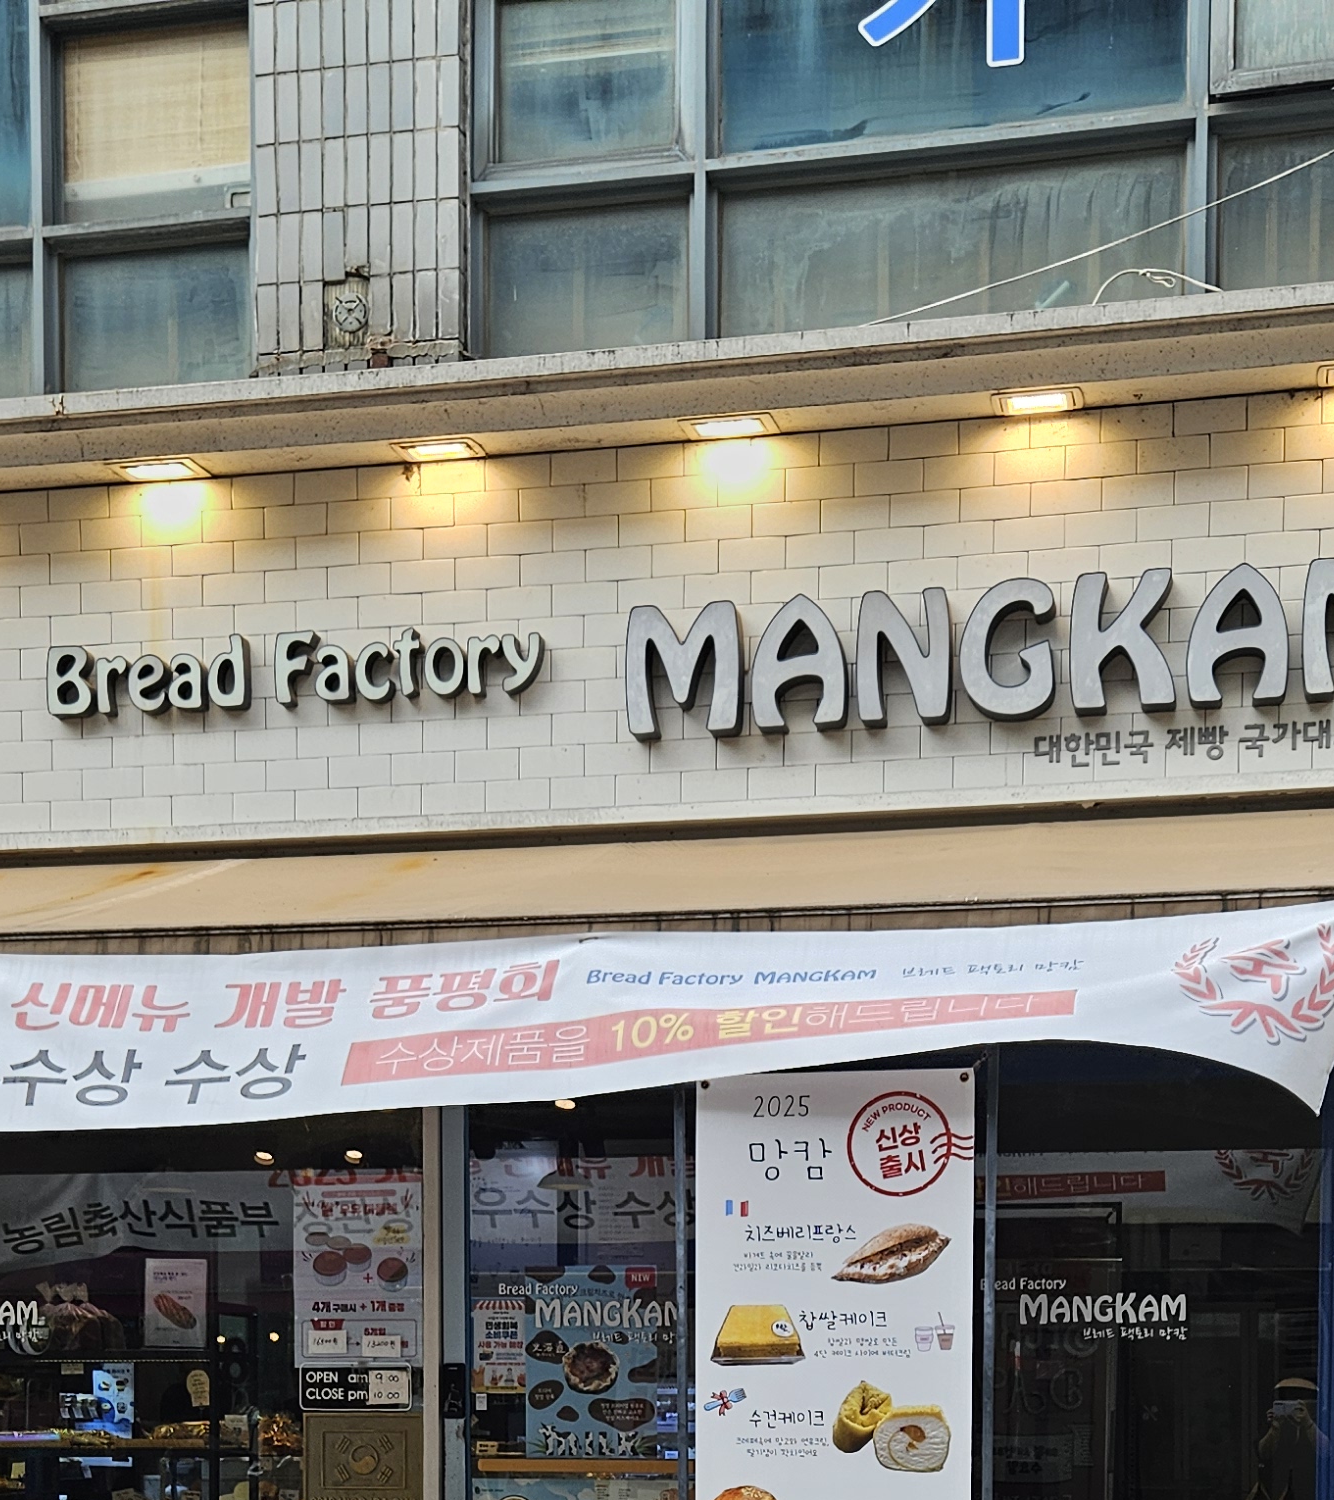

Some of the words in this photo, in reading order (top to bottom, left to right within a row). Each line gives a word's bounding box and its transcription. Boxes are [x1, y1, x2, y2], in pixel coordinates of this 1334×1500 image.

[46, 635, 250, 719] Bread
[274, 625, 547, 709] Factory
[1034, 726, 1152, 768] 대한민국
[1165, 722, 1230, 761] 제빵
[587, 968, 652, 986] Bread
[658, 970, 744, 989] Factory
[753, 966, 878, 985] MANGKAM
[11, 981, 192, 1032] 신메뉴
[214, 977, 347, 1031] 개발
[369, 959, 561, 1020] 품평회
[374, 1025, 591, 1075] 수상제품을
[611, 1013, 695, 1052] 10%
[164, 1044, 308, 1106] 수상
[753, 1095, 811, 1118] 2025
[862, 1111, 881, 1132] NEW
[882, 1102, 932, 1121] PRODUCT
[875, 1122, 921, 1152] 신상
[749, 1138, 833, 1181] 망캄
[879, 1150, 927, 1180] 출시
[2, 1197, 280, 1256] 농림축산식품부
[745, 1225, 857, 1244] 치즈베리프랑스
[499, 1284, 531, 1297] Bread
[535, 1283, 579, 1297] Factory
[980, 1278, 1016, 1291] Bead
[1019, 1276, 1067, 1291] Factory
[799, 1311, 887, 1331] 찹쌀케이크
[1019, 1292, 1187, 1325] MANGKAM
[306, 1371, 339, 1384] OPEN
[348, 1373, 369, 1384] am
[305, 1388, 345, 1401] CLOSE
[348, 1389, 369, 1402] pm
[749, 1410, 825, 1429] 수건케이크
